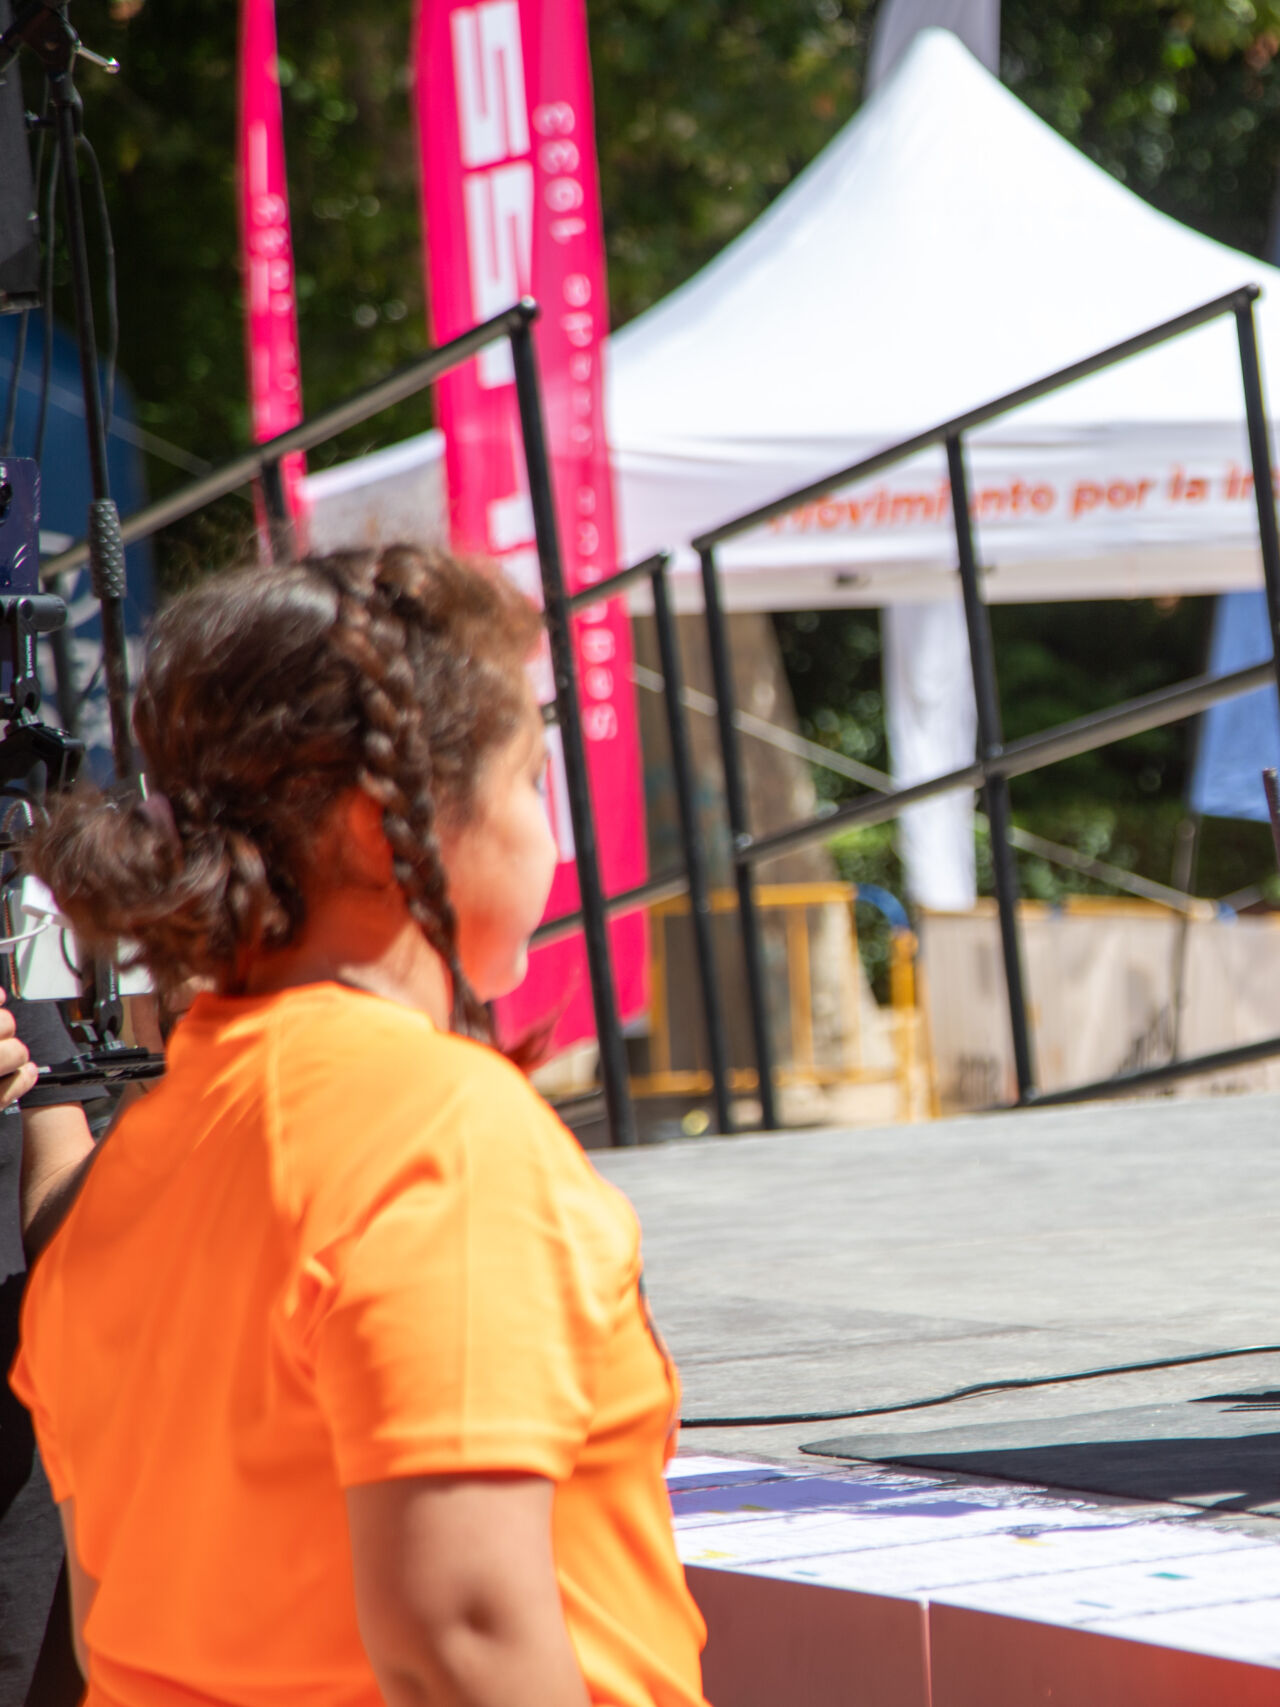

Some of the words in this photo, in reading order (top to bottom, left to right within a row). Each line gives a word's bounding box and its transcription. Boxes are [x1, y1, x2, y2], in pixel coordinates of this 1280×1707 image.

[532, 100, 587, 245] 1933
[767, 477, 1057, 534] oviminto
[1071, 477, 1151, 521] por
[1169, 463, 1208, 501] la
